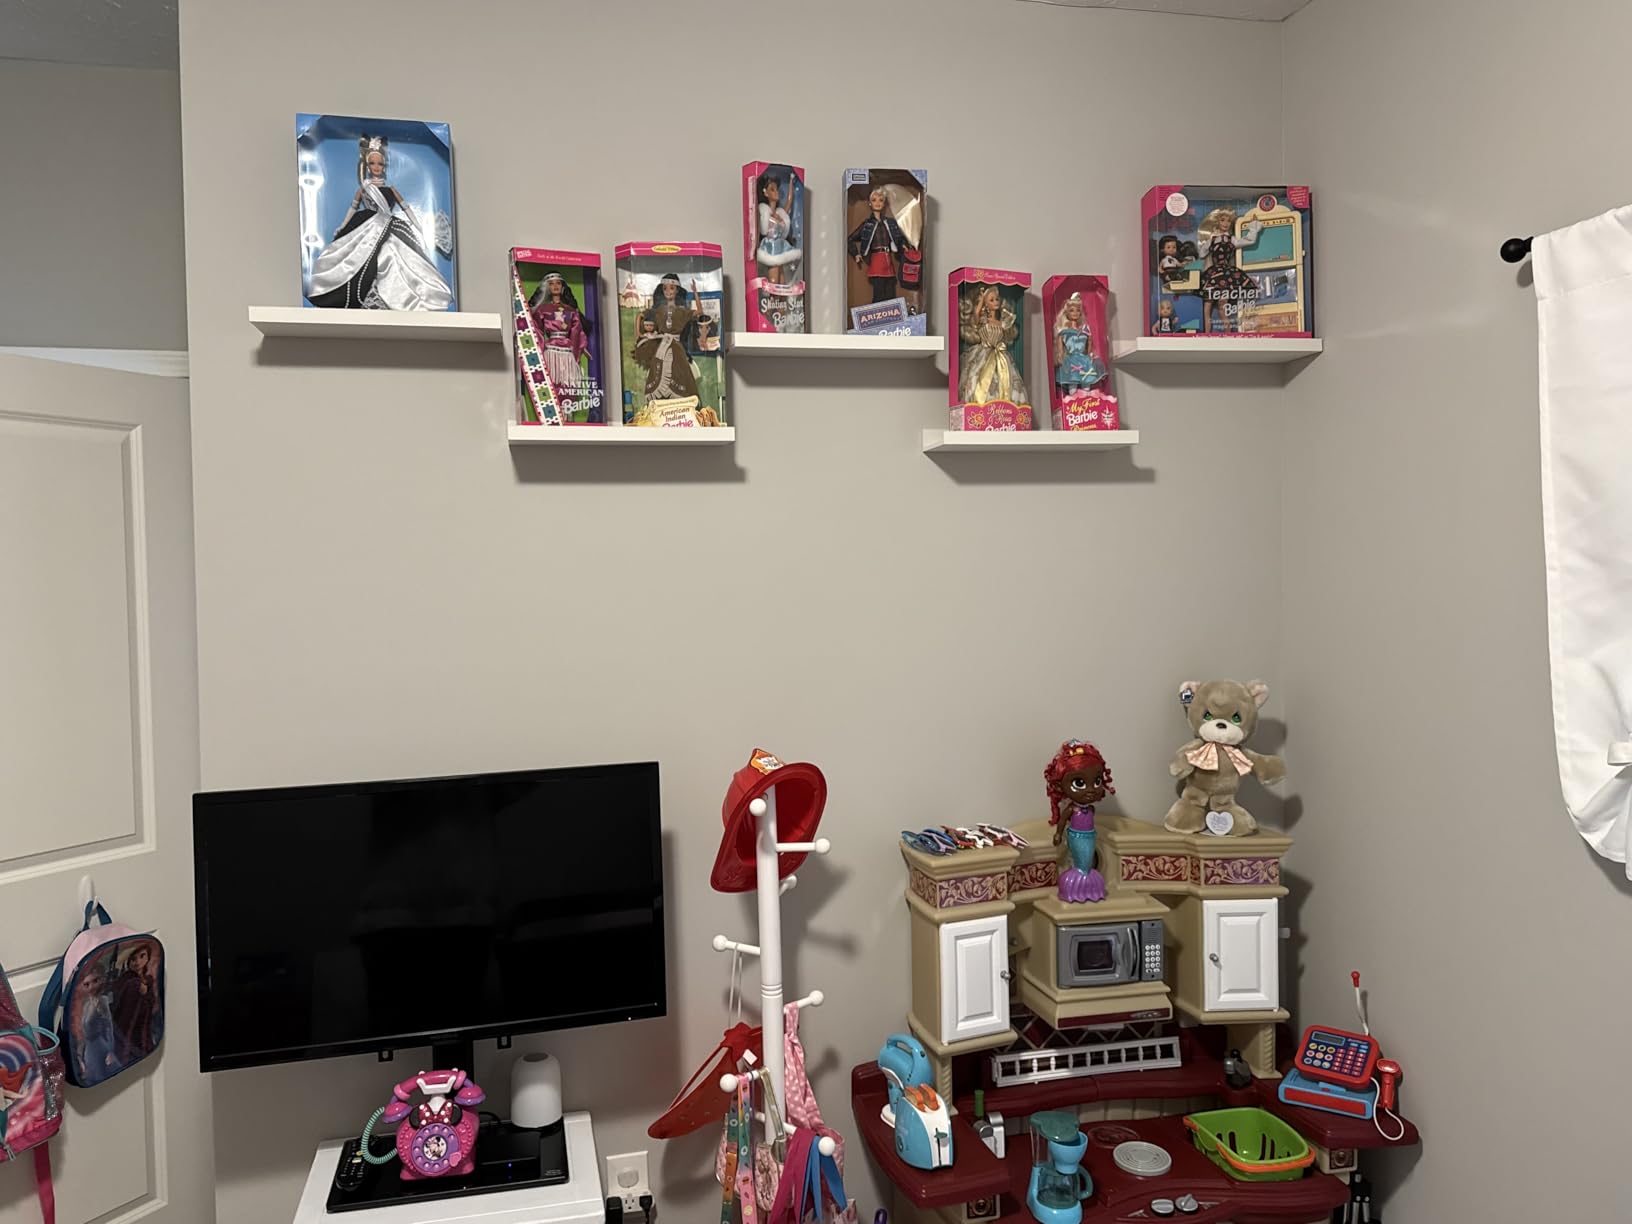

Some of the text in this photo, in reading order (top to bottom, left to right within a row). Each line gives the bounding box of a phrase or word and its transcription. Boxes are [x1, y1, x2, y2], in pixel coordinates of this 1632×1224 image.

[1206, 286, 1261, 300] Teacher
[761, 296, 804, 313] Skating Star
[1223, 298, 1256, 317] Barbie
[772, 311, 805, 328] Barbie
[860, 308, 900, 323] ARIZONA
[563, 380, 598, 389] NATIVE
[558, 388, 604, 397] AMERICAN
[561, 396, 601, 414] Barbie
[1069, 402, 1082, 414] My
[660, 407, 690, 418] American
[665, 414, 686, 422] Indian
[1066, 410, 1098, 426] Barbie
